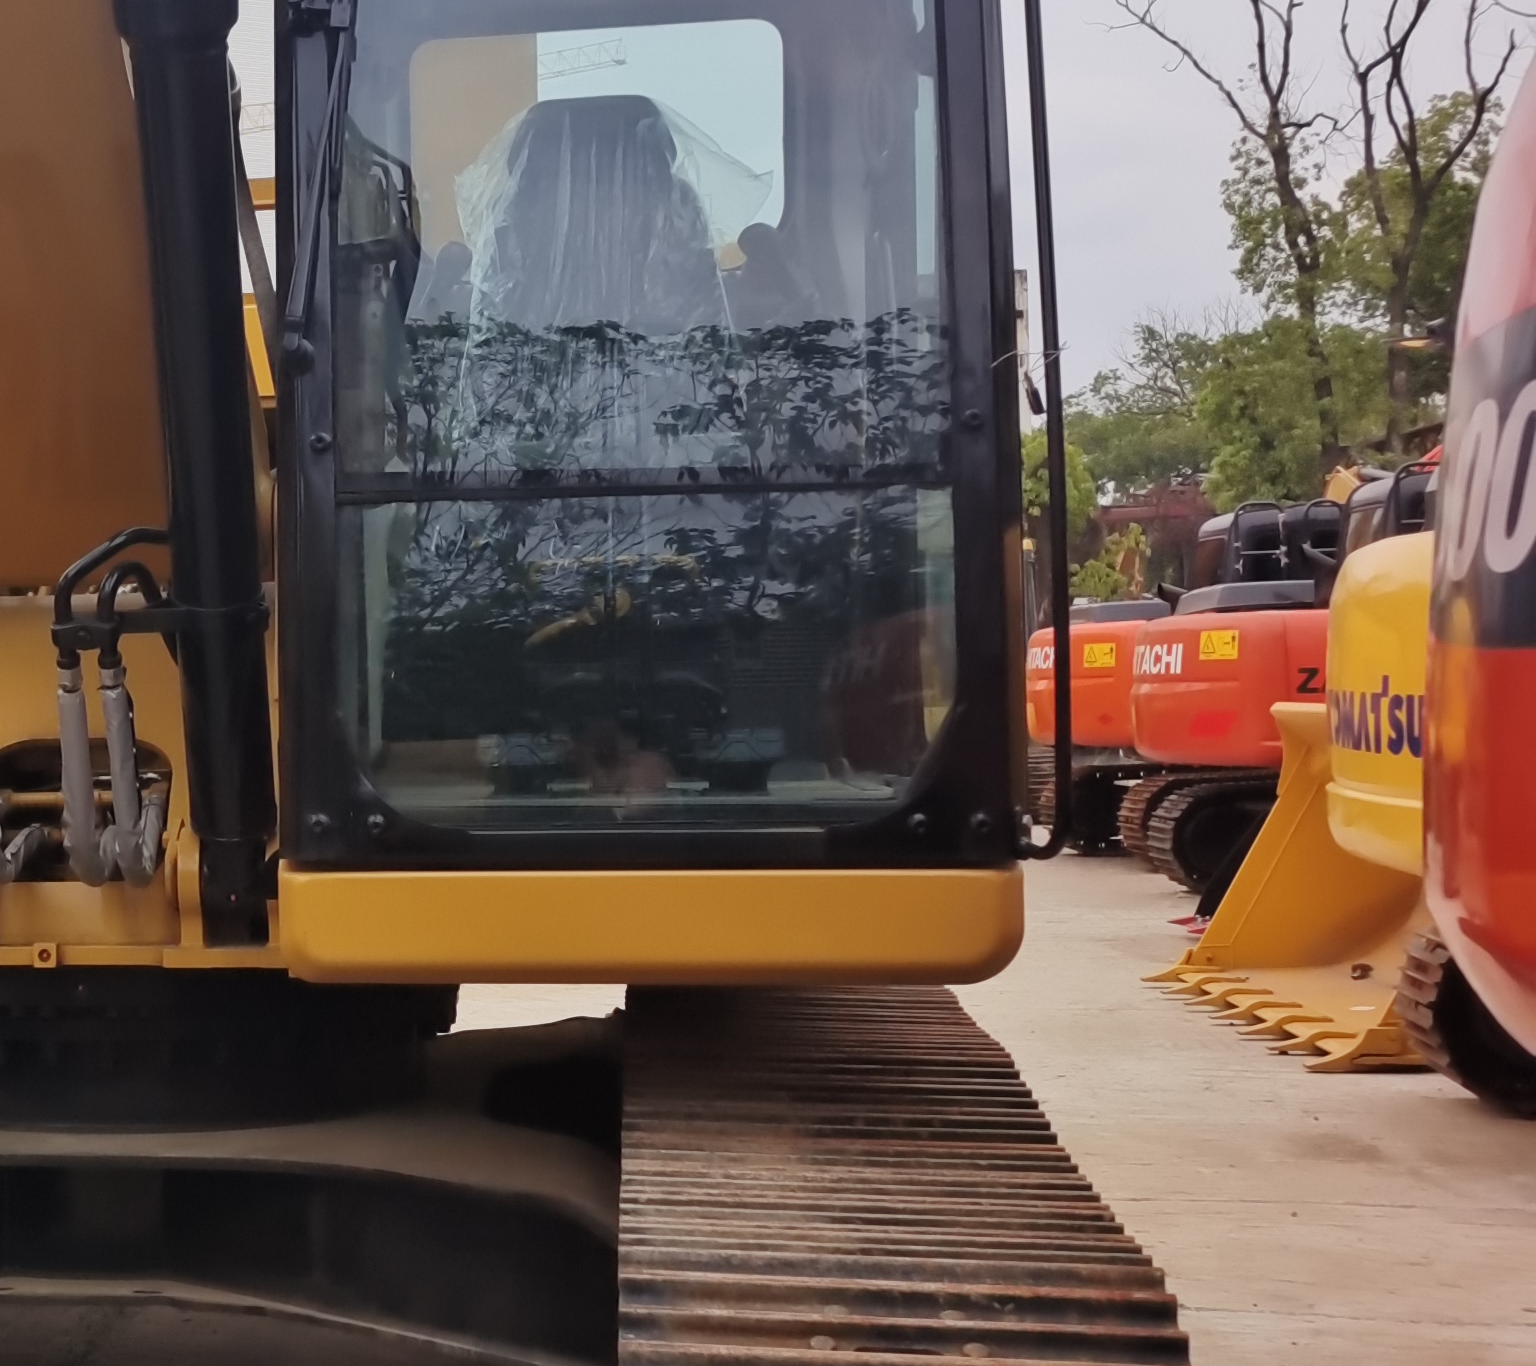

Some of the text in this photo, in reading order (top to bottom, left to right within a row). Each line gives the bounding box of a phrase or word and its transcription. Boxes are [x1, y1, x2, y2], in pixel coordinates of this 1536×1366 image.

[1444, 378, 1536, 582] 00
[1133, 642, 1183, 675] ITACHI
[1328, 674, 1424, 759] OMATSU
